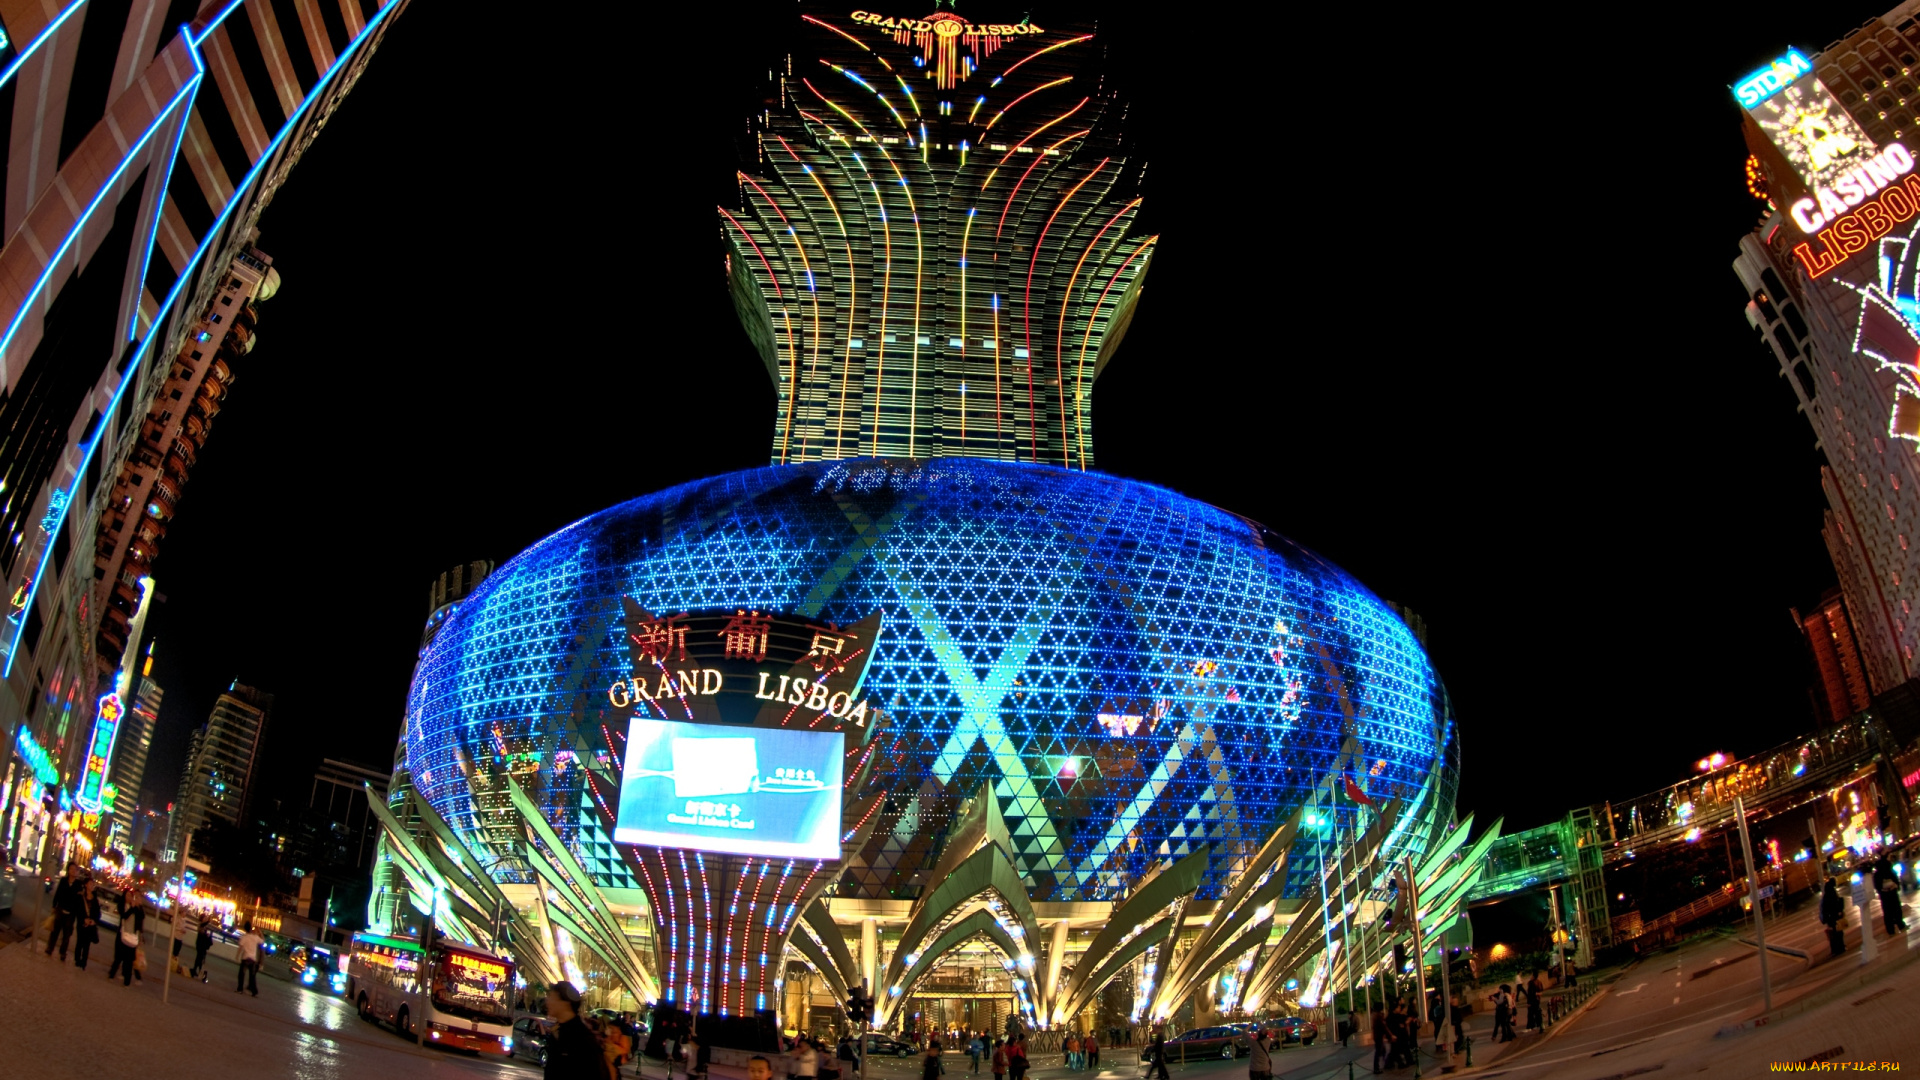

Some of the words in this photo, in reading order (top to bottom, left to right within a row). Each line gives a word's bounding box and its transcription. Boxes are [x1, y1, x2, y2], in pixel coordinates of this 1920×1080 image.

[850, 10, 932, 33] GRAND
[964, 23, 1045, 36] LISBOA
[1790, 142, 1914, 234] CASINO
[608, 668, 723, 708] GRAND
[754, 671, 869, 727] LISBOA
